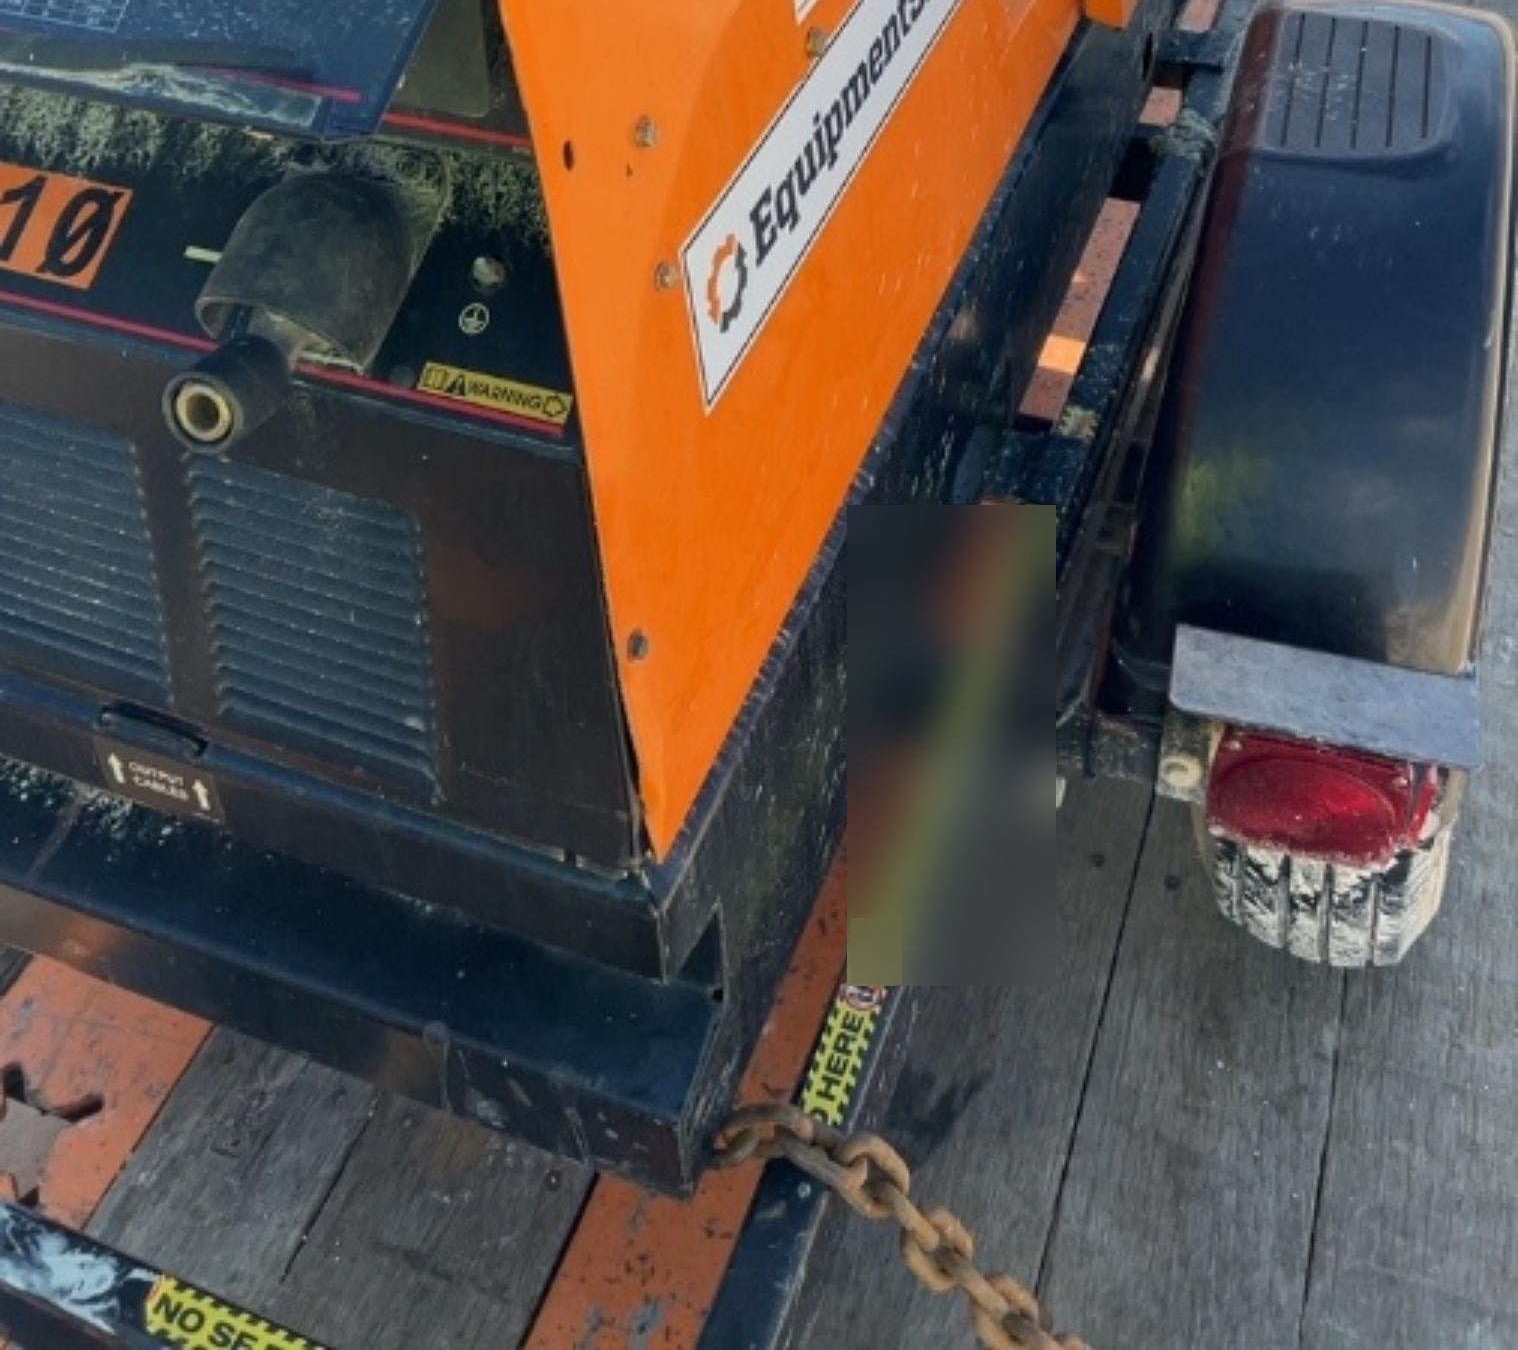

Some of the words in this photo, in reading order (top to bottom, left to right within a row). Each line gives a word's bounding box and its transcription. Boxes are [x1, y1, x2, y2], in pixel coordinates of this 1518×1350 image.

[467, 381, 544, 410] WARNING
[815, 1012, 864, 1102] HERE
[153, 1294, 206, 1333] NO
